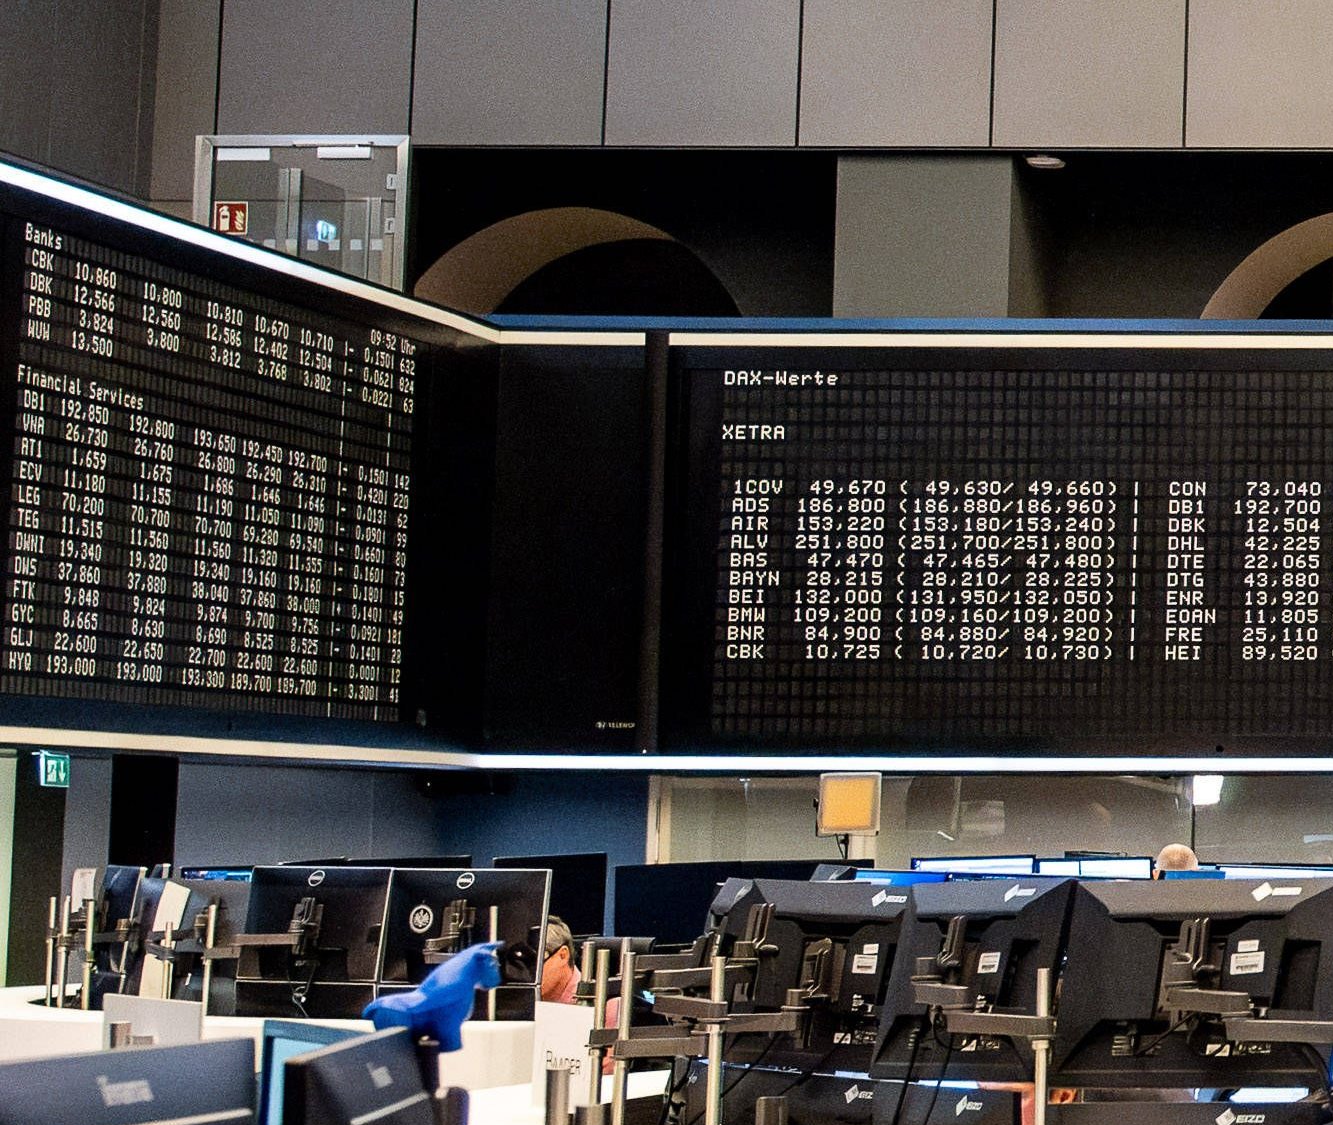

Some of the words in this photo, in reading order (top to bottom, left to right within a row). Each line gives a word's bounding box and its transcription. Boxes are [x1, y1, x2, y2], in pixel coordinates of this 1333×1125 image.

[25, 223, 62, 250] Banks
[32, 249, 54, 272] CBK
[75, 262, 117, 289] 10,860
[144, 282, 182, 308] 10,800
[207, 301, 243, 326] 10,810
[30, 272, 51, 294] DBK
[74, 285, 114, 312] 12,566
[142, 305, 180, 330] 12,560
[724, 370, 839, 386] DAX-Werte
[17, 364, 81, 396] Financial
[90, 382, 144, 410] Services
[24, 389, 45, 411] DB1
[61, 399, 109, 425] 192,850
[130, 414, 174, 439] 192,800
[194, 428, 236, 453] 193,650
[722, 424, 785, 440] XETRA
[734, 479, 783, 495] 1COV
[809, 479, 886, 495] 49,670
[732, 497, 770, 513] ADS
[798, 497, 885, 513] 186,800
[1168, 499, 1204, 515] DB1
[1234, 499, 1321, 515] 192,700
[731, 515, 769, 531] AIR
[797, 516, 885, 532] 153,220
[730, 534, 768, 549] ALV
[795, 534, 884, 550] 251,800
[1167, 535, 1205, 551] DHL
[1244, 535, 1321, 551] 42,225
[729, 570, 780, 586] BAYN
[806, 570, 883, 586] 28,215
[728, 588, 764, 604] BEI
[795, 589, 882, 604] 132,000
[728, 607, 766, 622] BMW
[794, 607, 882, 623] 109,200
[11, 627, 32, 647] GLJ
[54, 632, 96, 653] 22,600
[124, 640, 164, 660] 22,650
[726, 644, 764, 659] CBK
[805, 644, 881, 660] 10,725
[1165, 644, 1201, 661] HEI
[1242, 645, 1318, 661] 89,520
